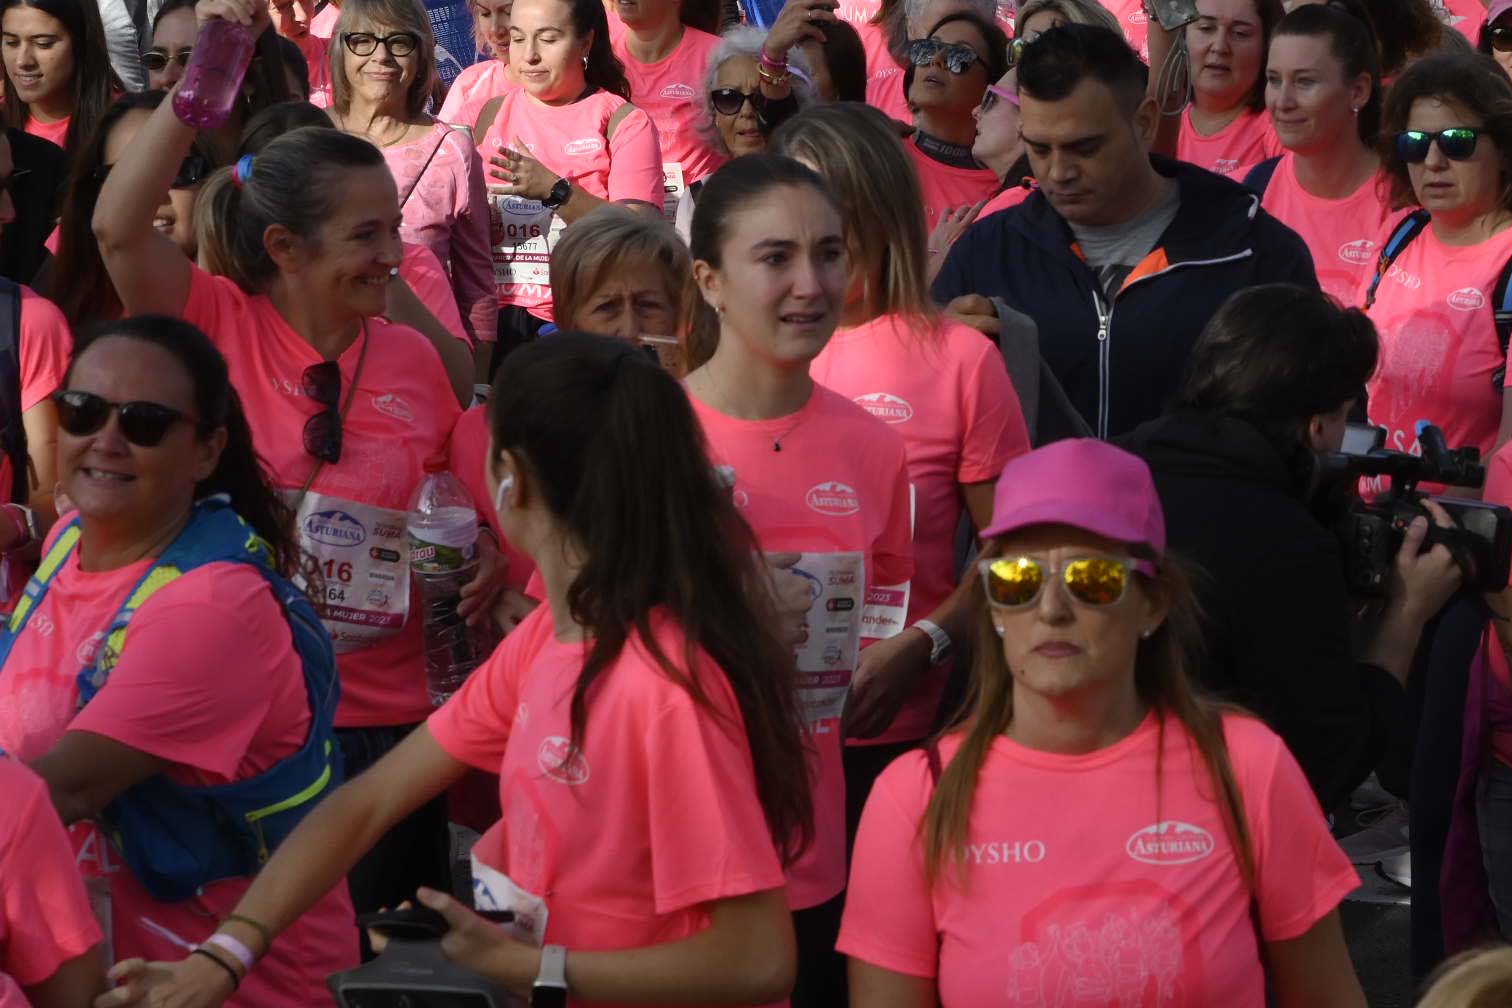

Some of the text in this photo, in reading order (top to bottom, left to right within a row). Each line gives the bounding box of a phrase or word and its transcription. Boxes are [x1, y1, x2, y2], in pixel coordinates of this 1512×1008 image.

[504, 197, 544, 211] ASTURIAN
[507, 223, 541, 238] 016
[863, 404, 908, 418] TURIANA
[304, 516, 362, 542] ASTURIANA
[310, 558, 353, 582] 16
[333, 610, 367, 622] MUJER
[1134, 836, 1210, 855] ASTURIANA
